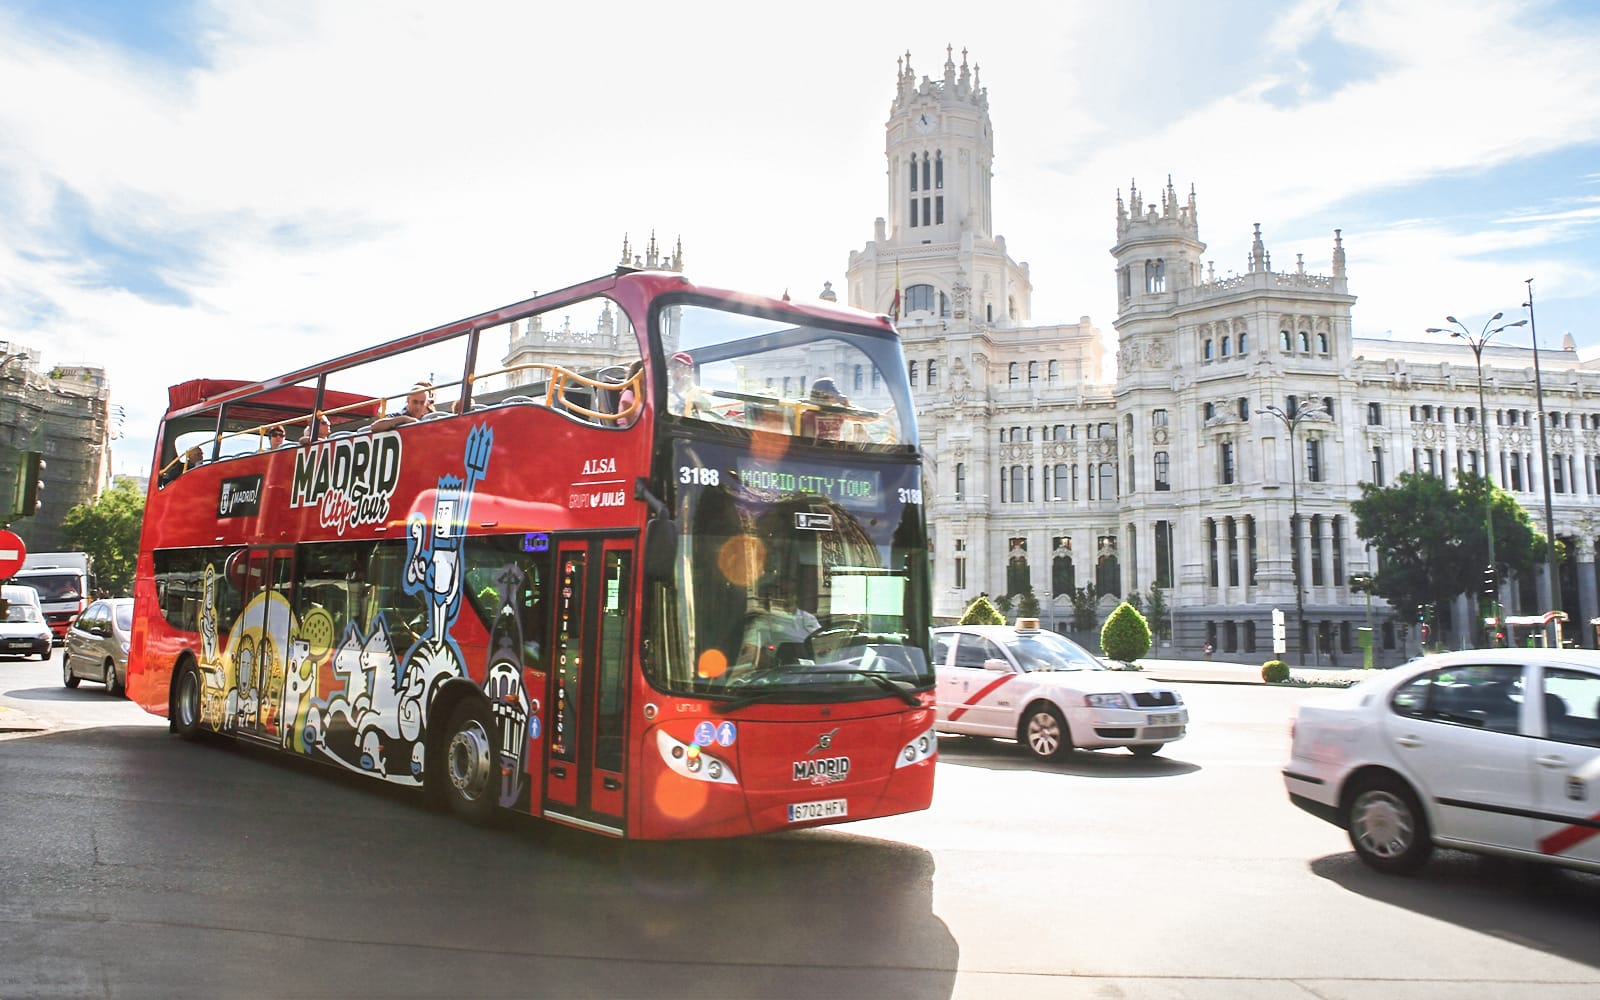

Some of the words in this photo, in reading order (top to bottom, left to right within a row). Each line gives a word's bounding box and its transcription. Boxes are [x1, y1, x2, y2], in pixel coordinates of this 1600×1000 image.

[290, 431, 402, 508] MADRID
[581, 458, 616, 475] ALSA
[680, 466, 719, 486] 3188
[741, 470, 796, 491] MADRID
[798, 475, 835, 496] CITY
[838, 479, 872, 498] TOUR
[320, 488, 350, 536] City
[349, 484, 390, 528] Tour
[793, 756, 850, 781] MADRID
[795, 804, 823, 819] 6702
[825, 801, 846, 816] HFV
